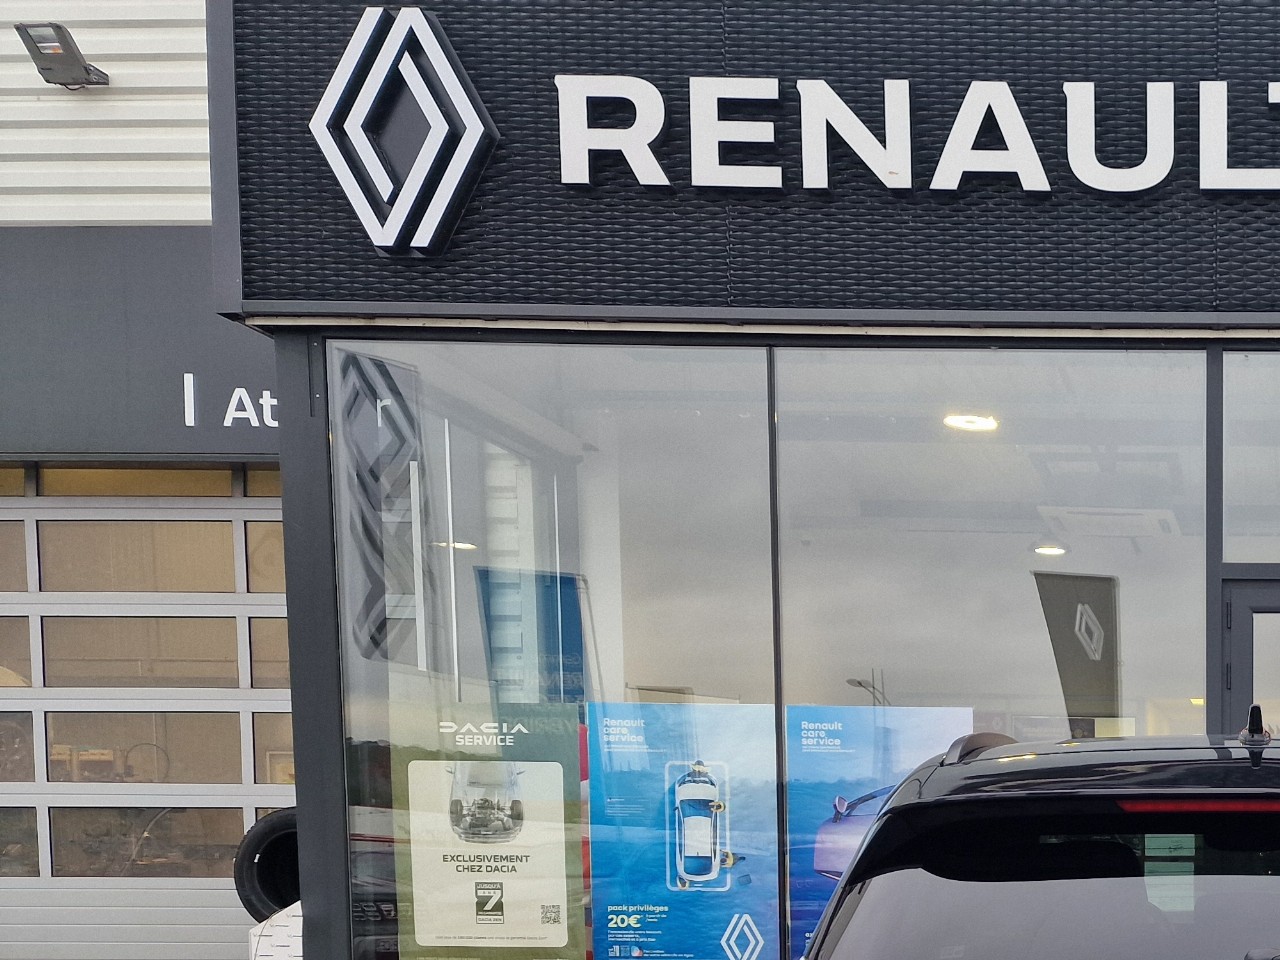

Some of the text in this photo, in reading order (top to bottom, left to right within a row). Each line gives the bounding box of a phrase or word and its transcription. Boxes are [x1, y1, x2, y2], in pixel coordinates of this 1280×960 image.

[603, 718, 646, 727] Renault
[801, 721, 843, 730] Renault
[439, 722, 530, 734] DACIA
[603, 726, 629, 734] care
[603, 733, 644, 742] service
[801, 730, 826, 738] care
[455, 735, 515, 746] SERVICE
[801, 736, 841, 746] service
[442, 854, 530, 863] EXCLUSIVEMENT
[455, 864, 518, 873] CHEZ DACIA
[607, 904, 669, 913] pack privilèges
